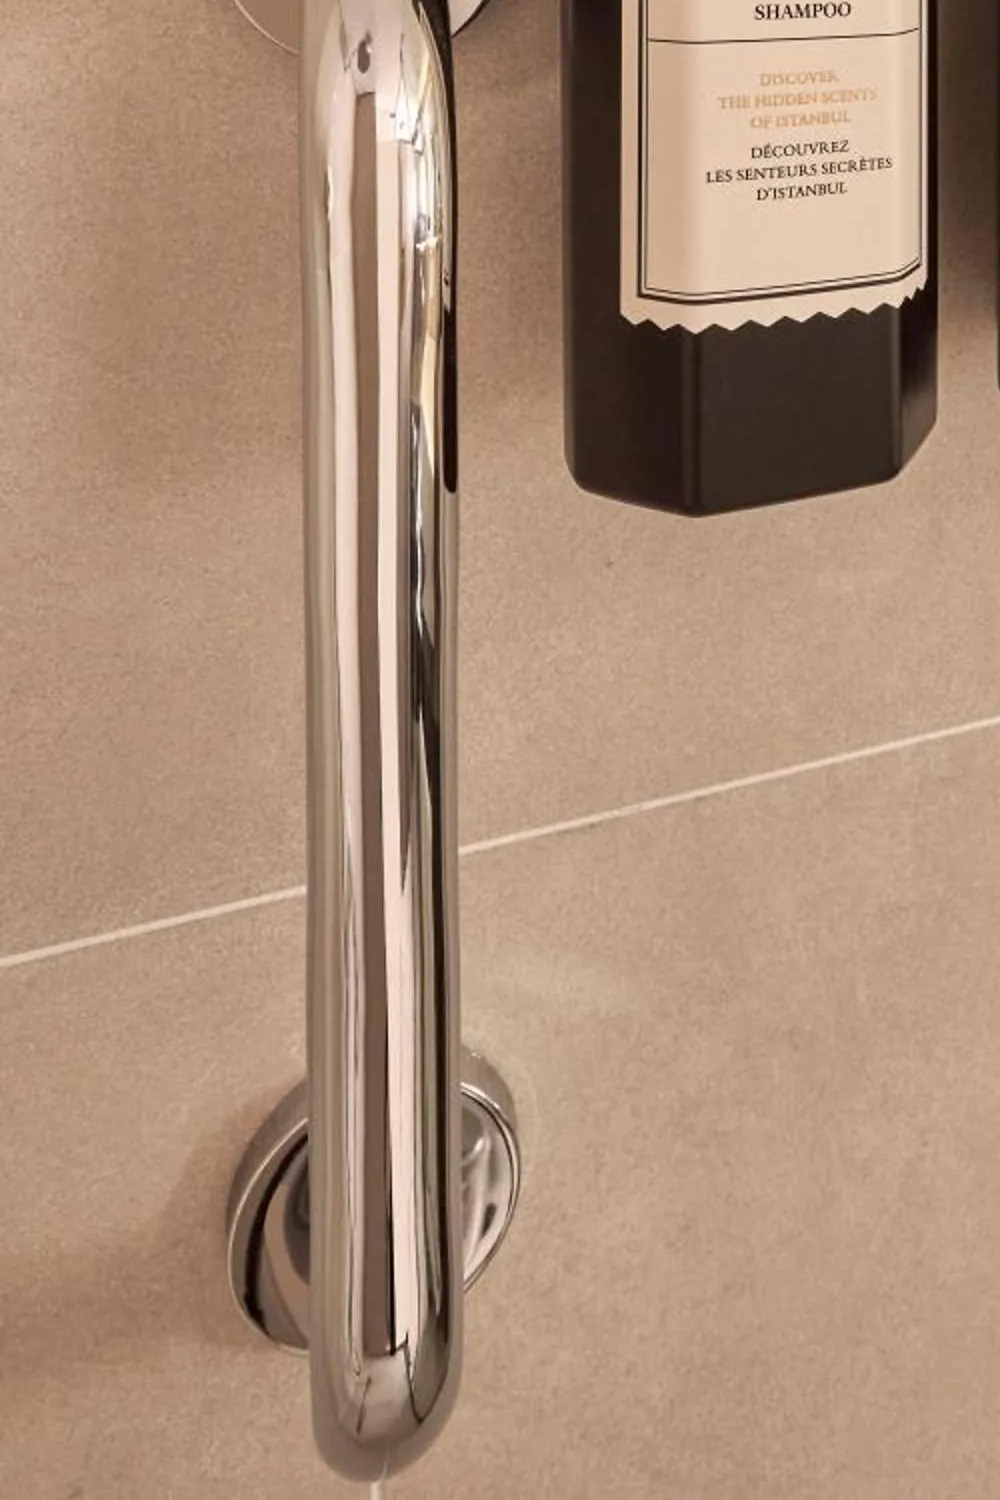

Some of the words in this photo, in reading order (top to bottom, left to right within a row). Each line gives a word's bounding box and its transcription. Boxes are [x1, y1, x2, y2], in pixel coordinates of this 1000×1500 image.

[754, 1, 852, 21] SHAMPOO
[759, 70, 840, 87] DISCOVER
[718, 96, 751, 110] THE
[754, 92, 818, 109] HIDDEN
[821, 87, 879, 105] SCENTS
[750, 115, 774, 129] OF
[776, 111, 851, 128] ISTANBUL
[750, 139, 850, 160] DÉCOUVREZ
[706, 171, 733, 184] LES
[736, 163, 817, 182] SENTEURS
[821, 157, 893, 176] SECRÈTES
[756, 182, 848, 201] D'ISTANBUL
